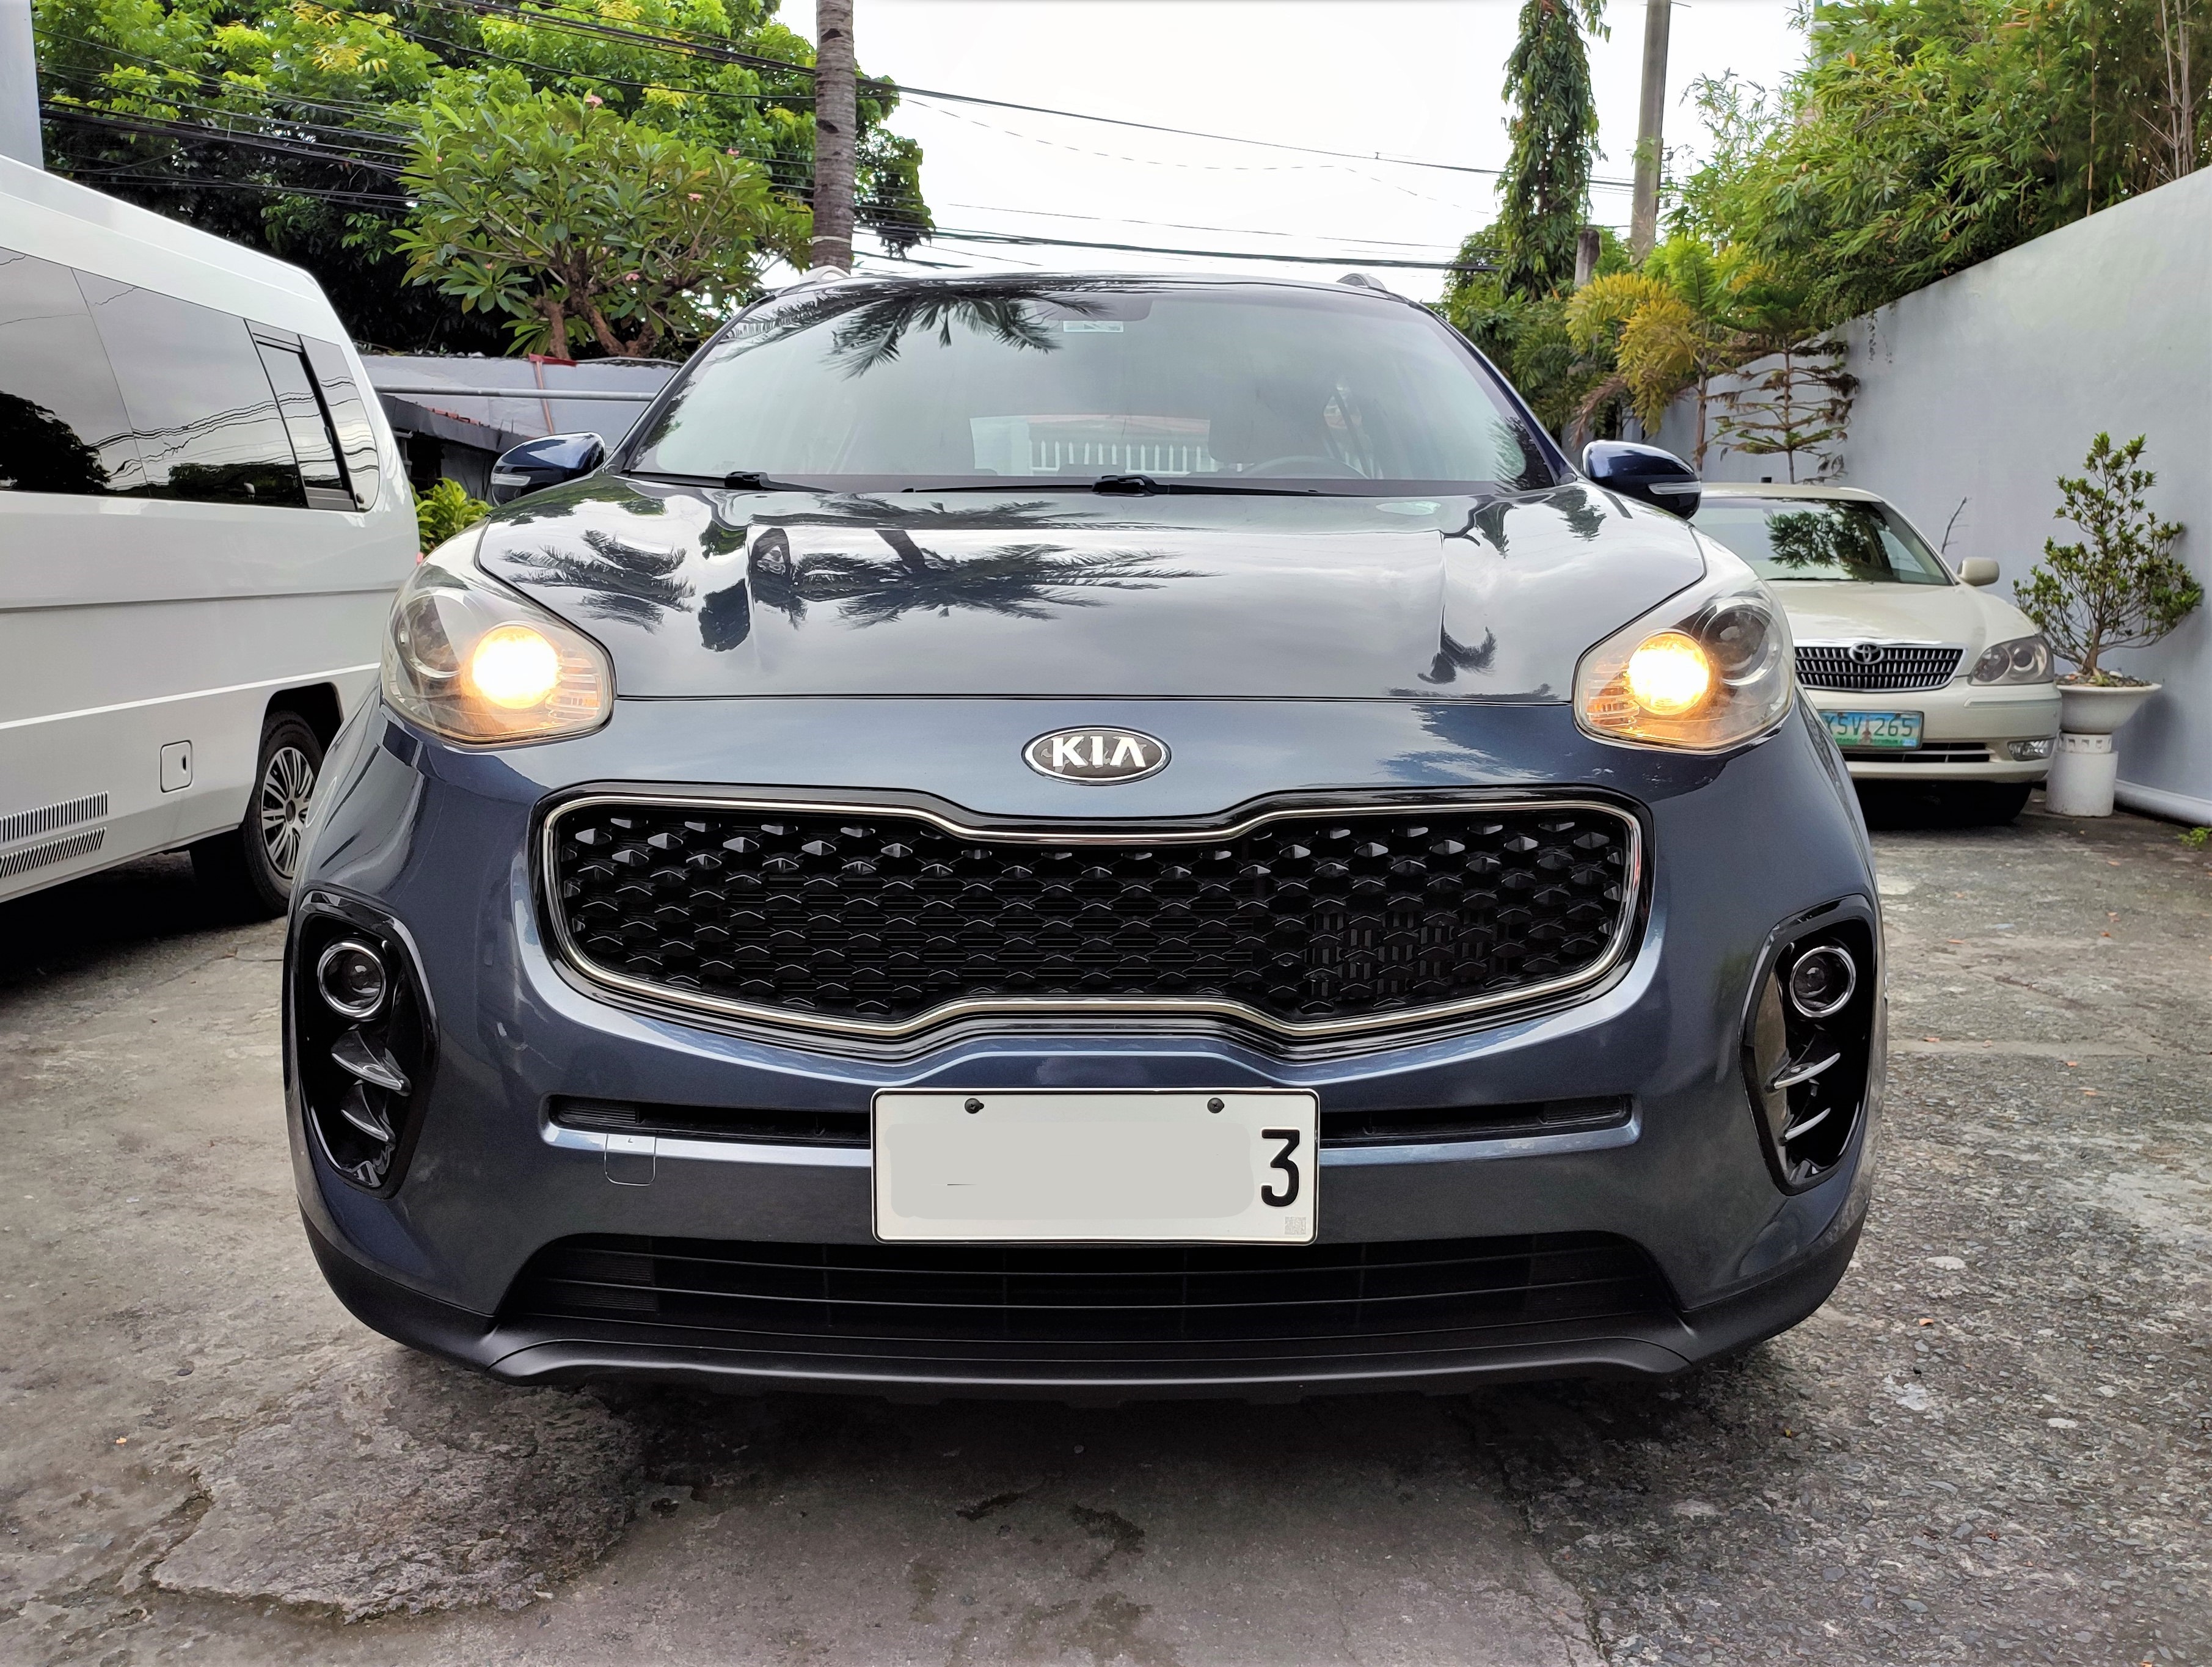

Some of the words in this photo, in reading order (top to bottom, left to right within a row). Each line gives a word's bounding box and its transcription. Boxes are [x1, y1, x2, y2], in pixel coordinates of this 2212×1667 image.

[1873, 717, 1913, 737] 265
[1051, 735, 1146, 768] KIA
[1261, 1129, 1300, 1207] 3
